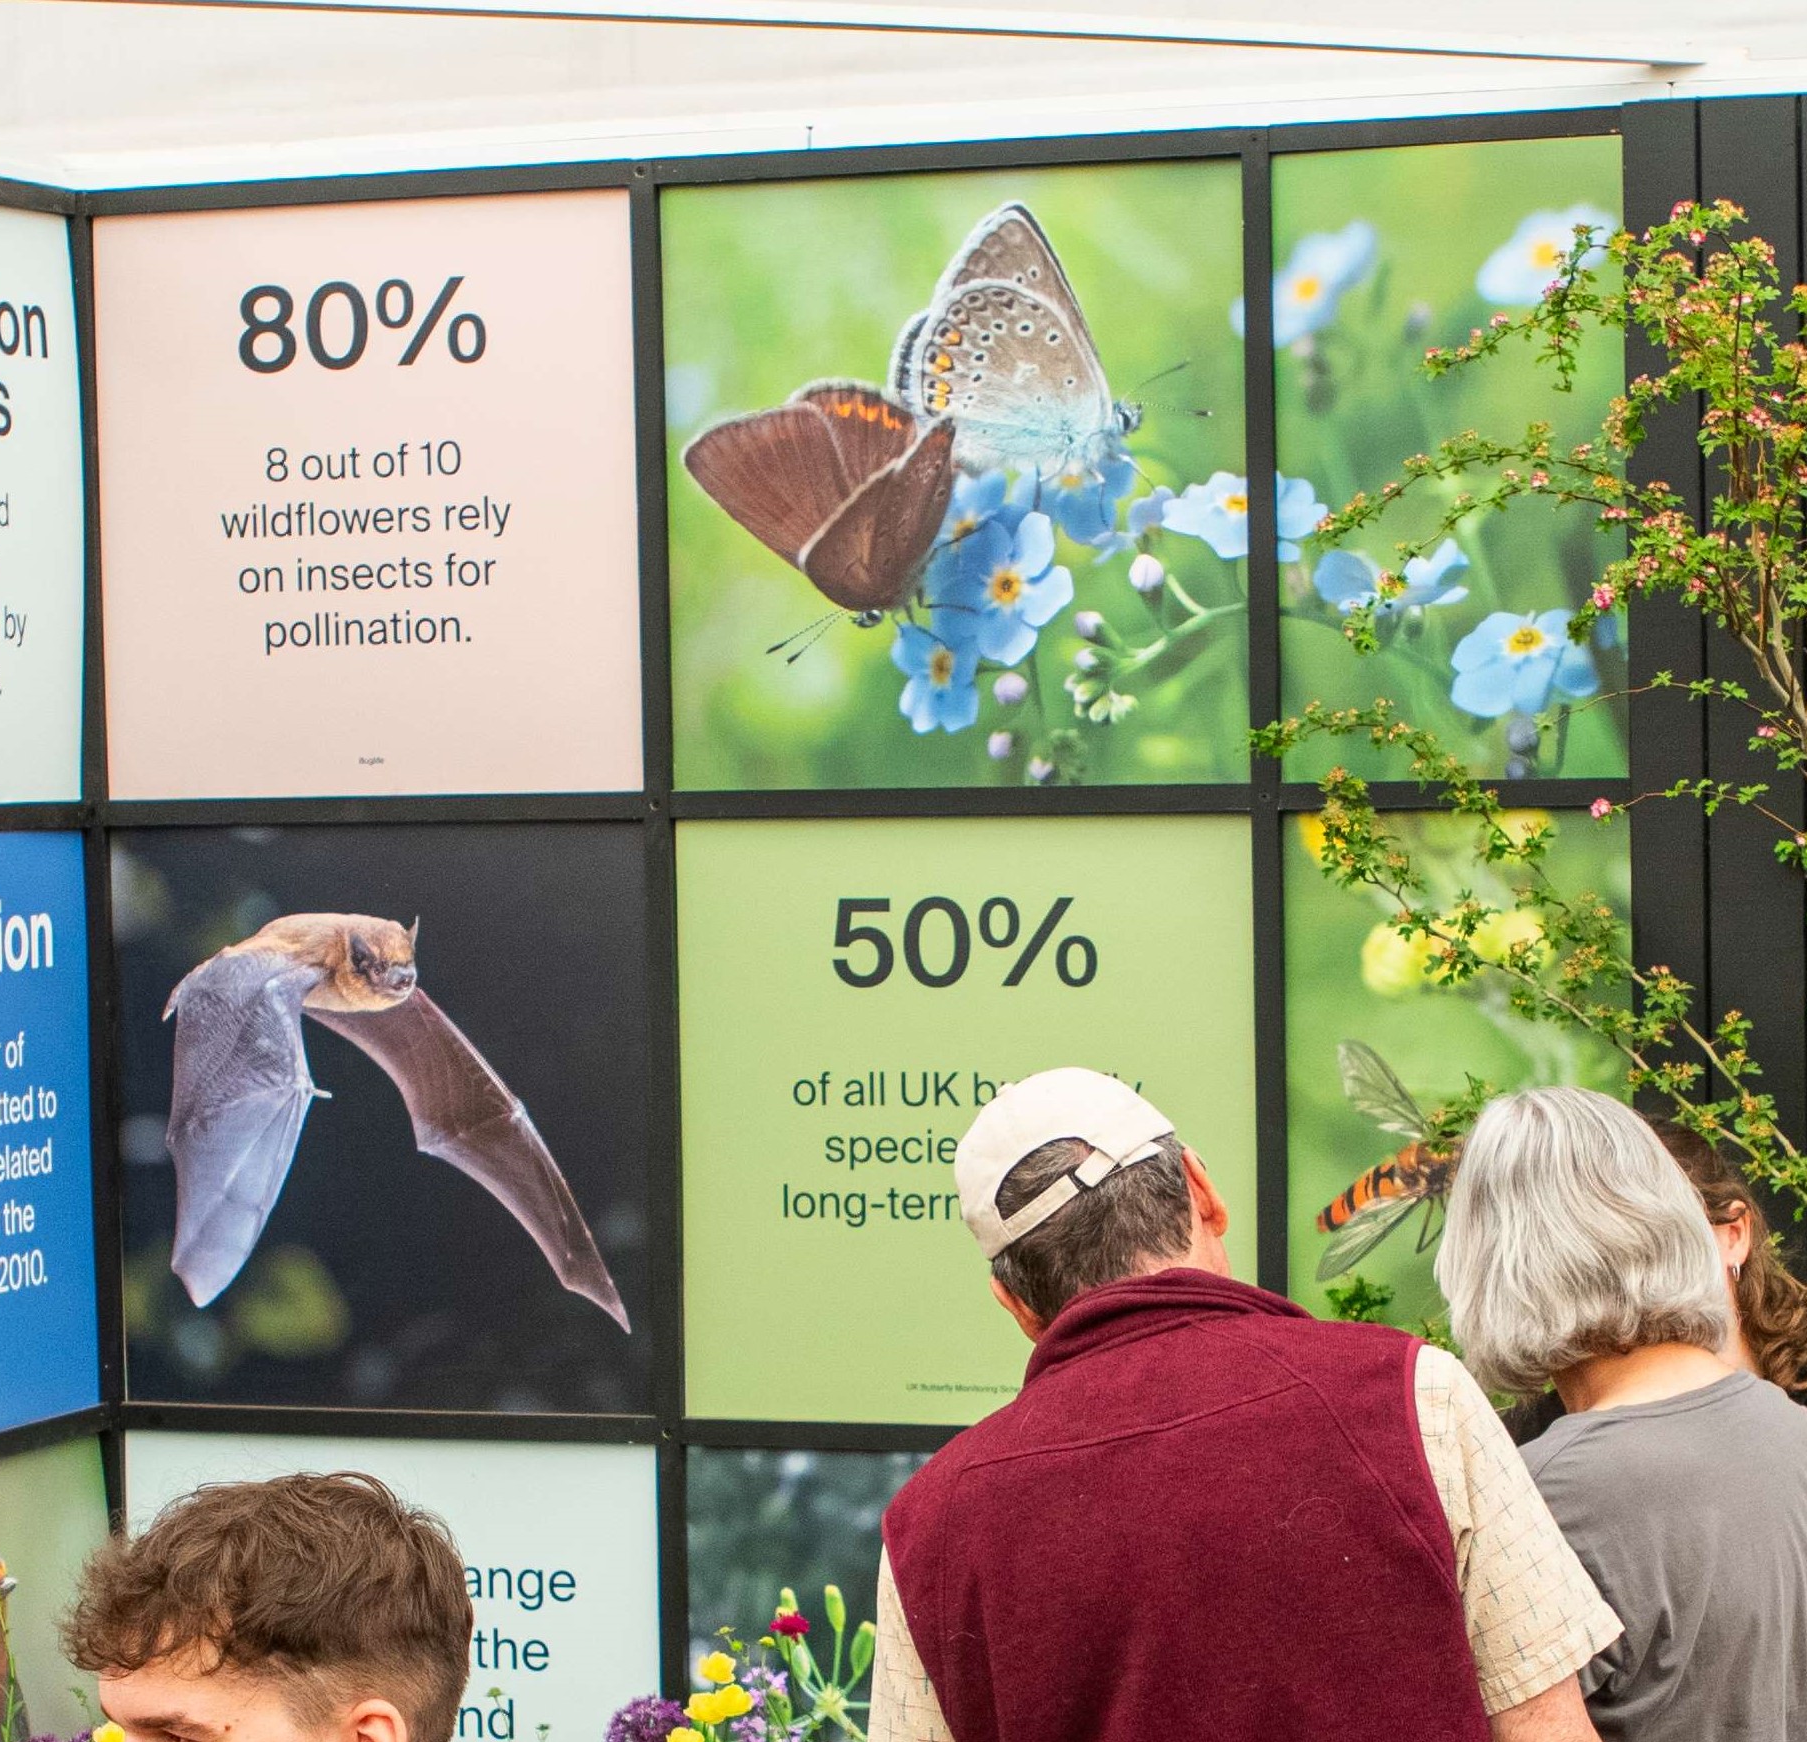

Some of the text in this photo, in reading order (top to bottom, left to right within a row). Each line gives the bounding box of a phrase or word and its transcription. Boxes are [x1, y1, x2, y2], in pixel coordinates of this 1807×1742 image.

[238, 276, 487, 374] 80%
[265, 440, 462, 482] 8 out of 10
[221, 496, 511, 539] wildflowers rely
[238, 552, 496, 594] on insects for
[2, 611, 27, 647] by
[265, 610, 473, 656] pollination.
[831, 895, 1099, 988] 50%
[6, 1031, 26, 1068] of
[38, 1086, 57, 1119] to
[792, 1072, 831, 1107] of
[843, 1071, 886, 1107] all
[900, 1071, 960, 1107] UK
[824, 1128, 958, 1170] specie
[4, 1199, 35, 1237] the
[473, 1627, 550, 1671] the
